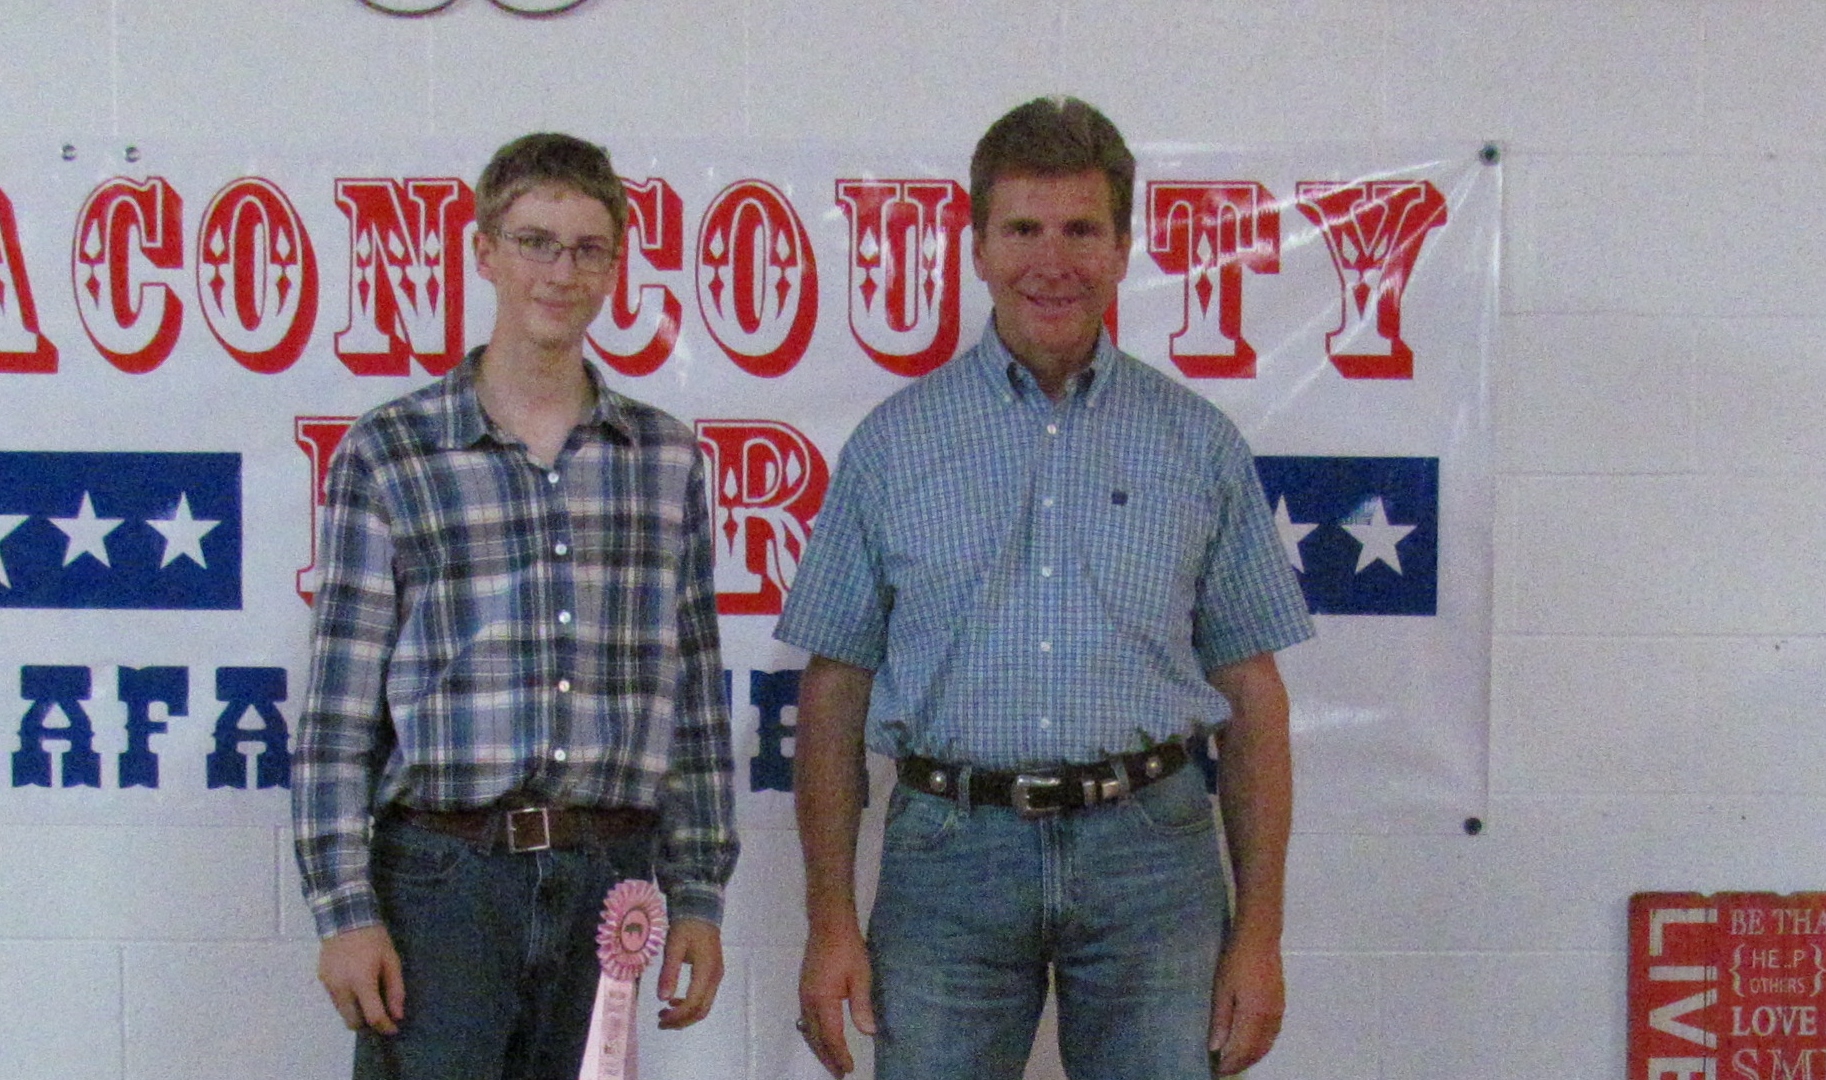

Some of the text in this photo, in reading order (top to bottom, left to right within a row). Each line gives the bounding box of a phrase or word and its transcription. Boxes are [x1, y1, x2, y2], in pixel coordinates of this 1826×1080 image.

[583, 176, 1448, 379] COUTY
[1730, 908, 1765, 935] BE
[1731, 1005, 1818, 1037] LOVE
